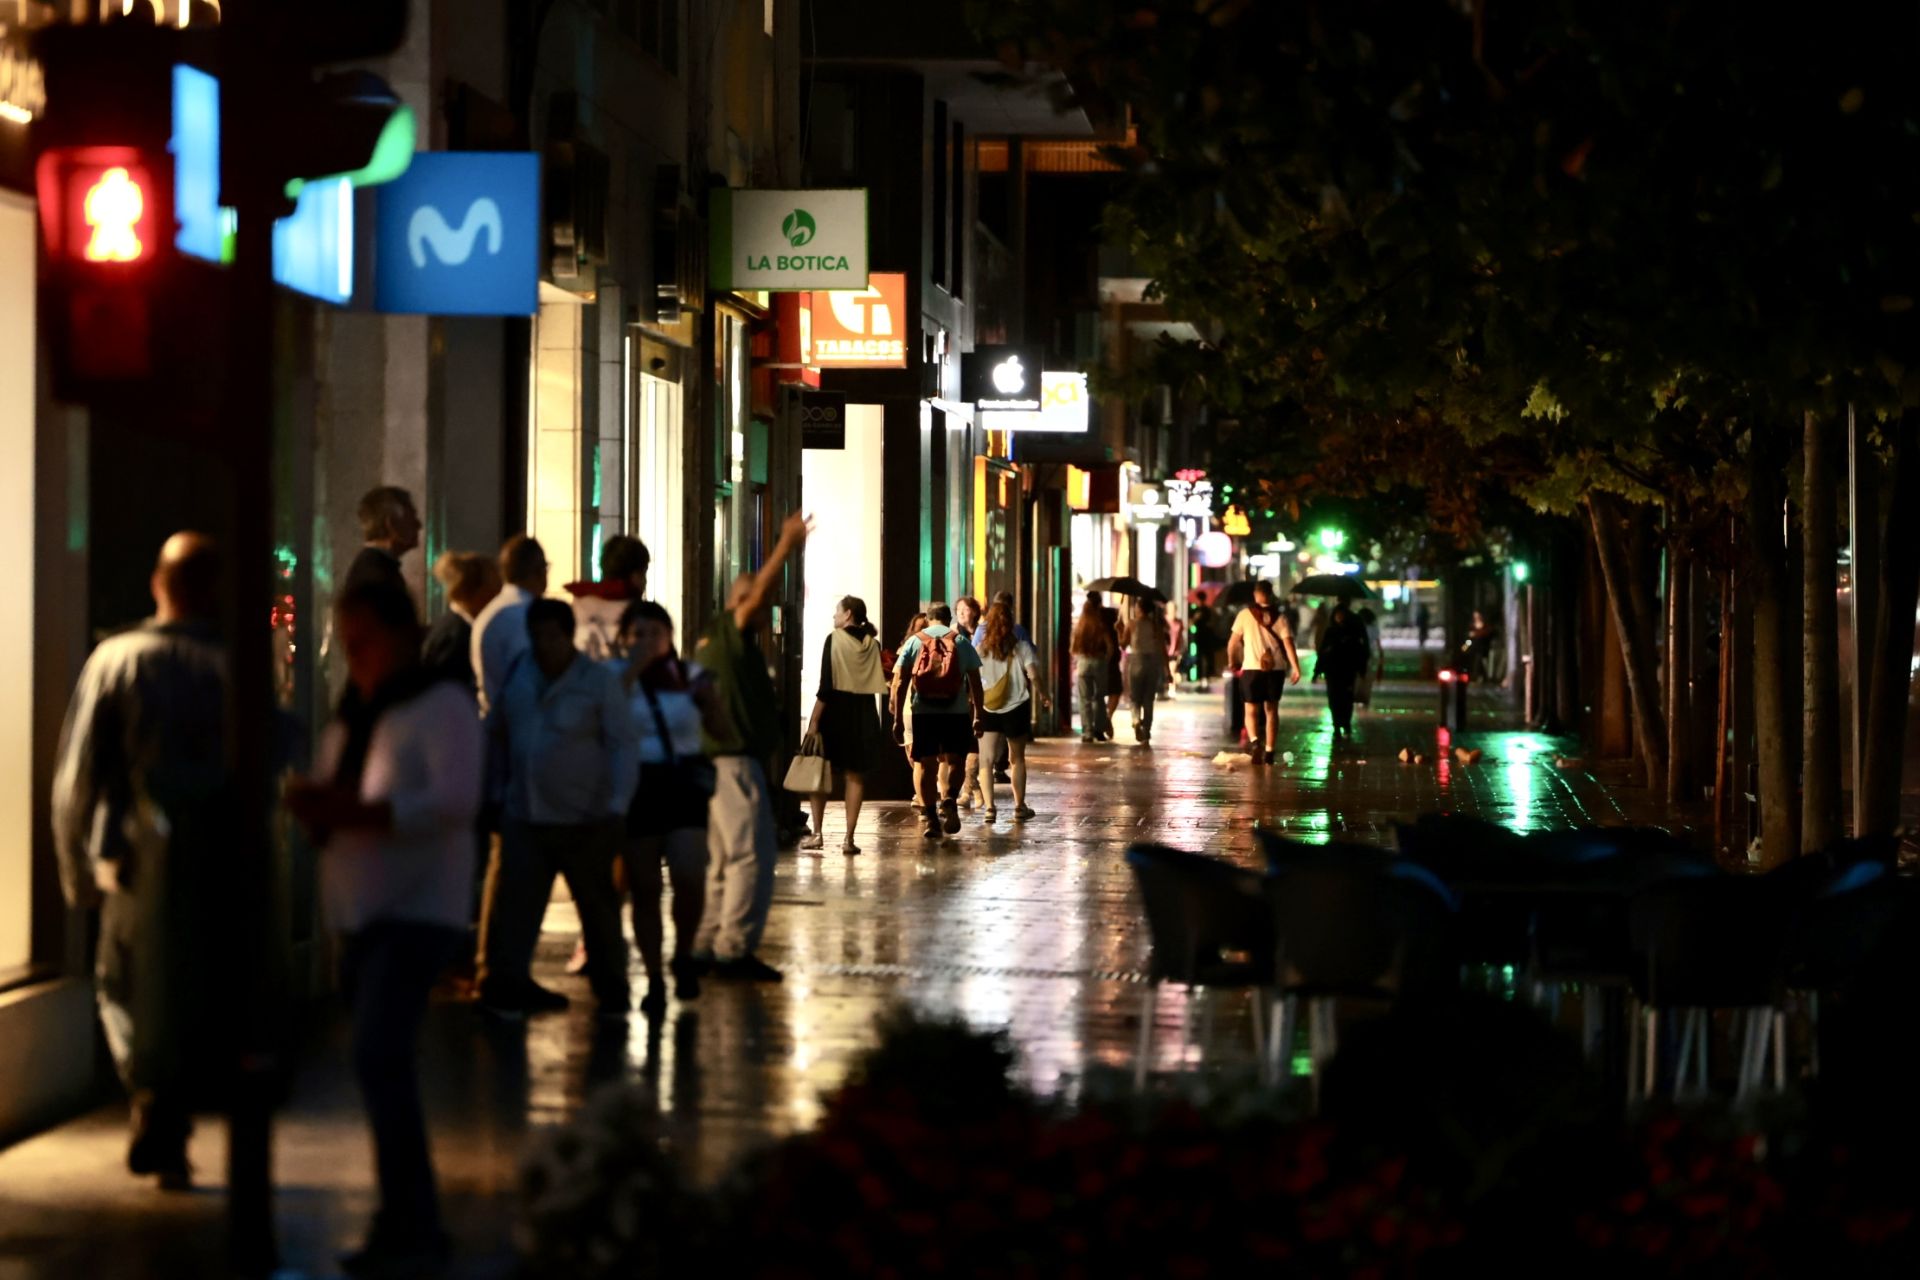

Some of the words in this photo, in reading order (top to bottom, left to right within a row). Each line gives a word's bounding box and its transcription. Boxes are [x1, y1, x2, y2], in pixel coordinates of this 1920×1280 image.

[747, 255, 772, 271] LA
[776, 255, 850, 271] BOTICA
[815, 339, 904, 355] TABACOS
